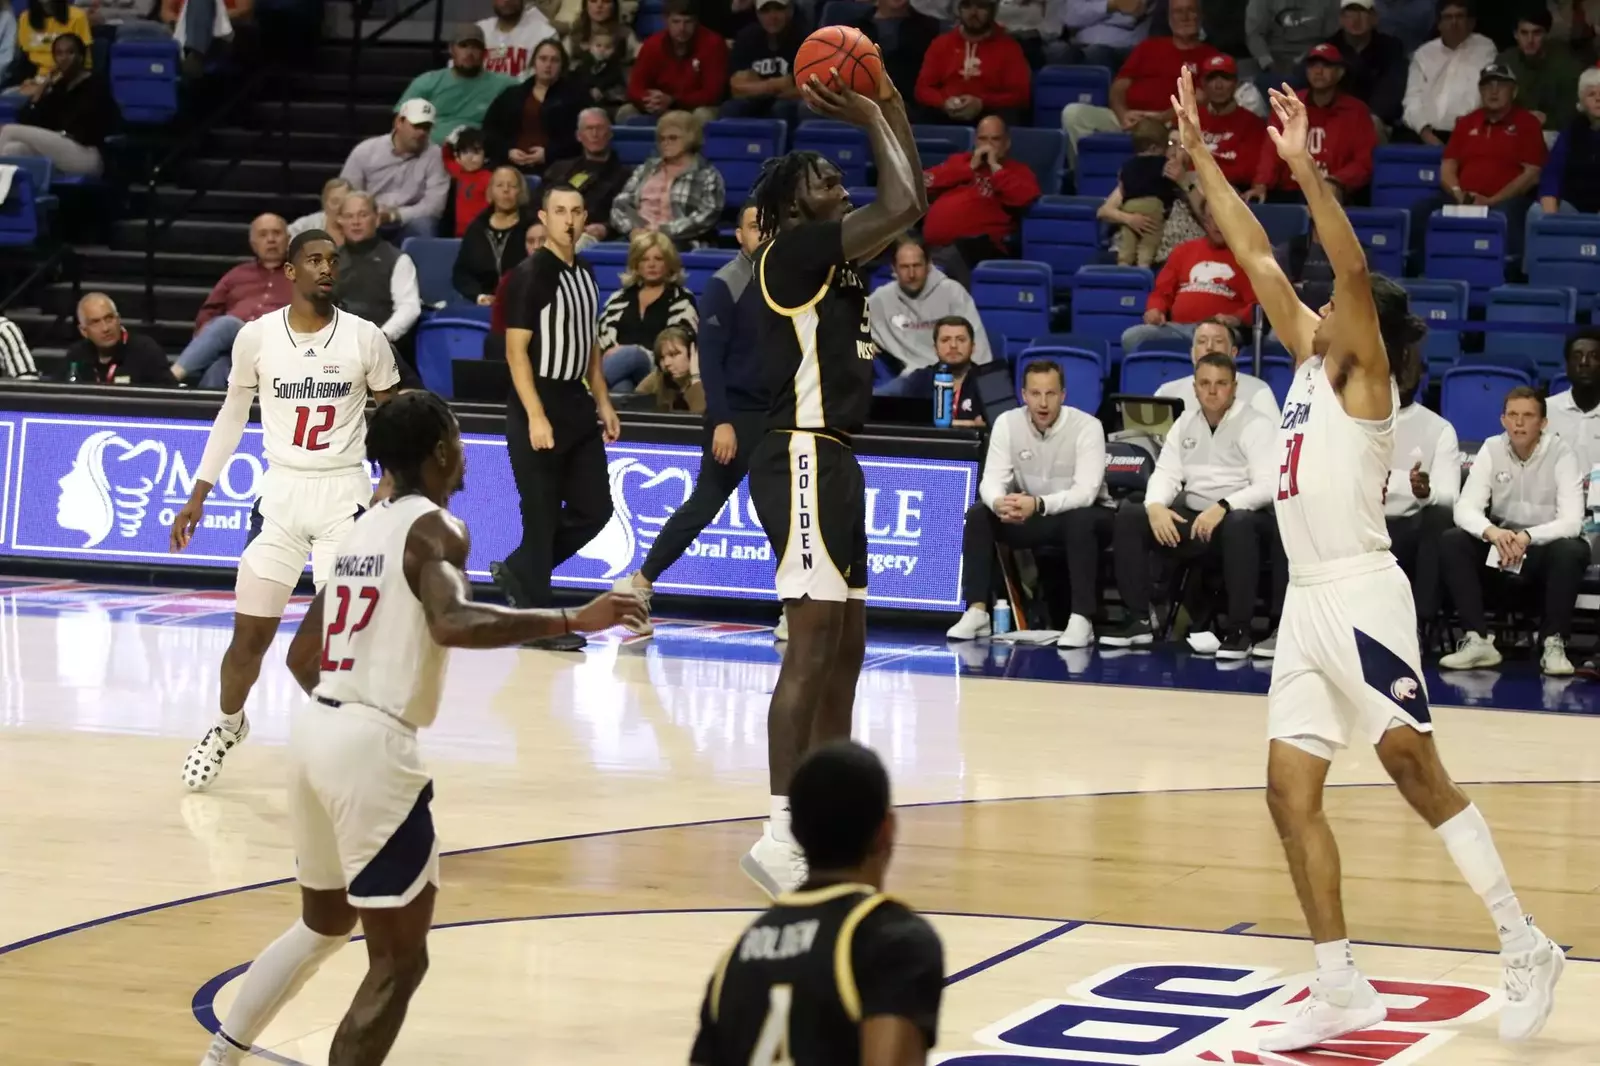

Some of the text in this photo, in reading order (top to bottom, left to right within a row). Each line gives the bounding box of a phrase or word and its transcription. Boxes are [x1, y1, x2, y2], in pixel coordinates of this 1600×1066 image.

[292, 405, 336, 451] 12
[203, 510, 242, 529] and
[798, 454, 813, 570] GOLDEN
[731, 540, 770, 561] and
[867, 553, 919, 576] rgery
